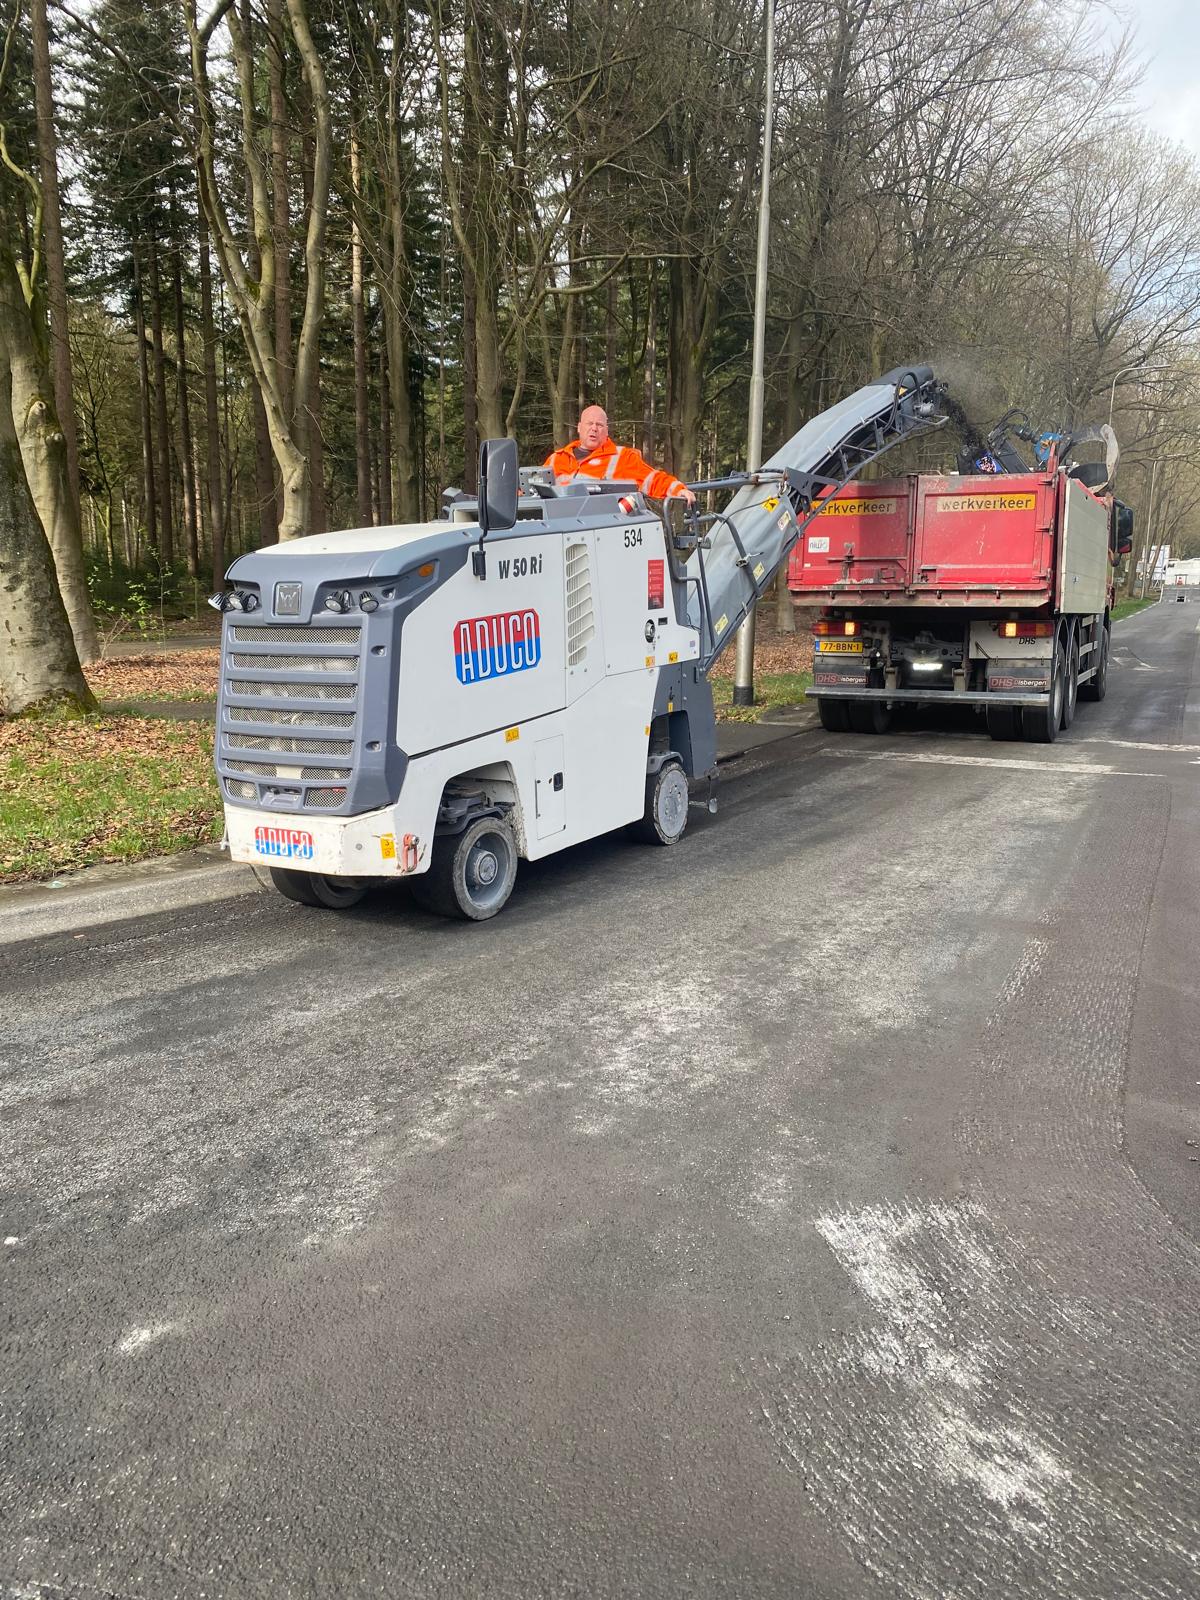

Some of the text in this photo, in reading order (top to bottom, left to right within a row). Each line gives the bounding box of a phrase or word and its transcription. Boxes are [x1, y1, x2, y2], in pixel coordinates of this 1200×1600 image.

[815, 502, 893, 515] erkverkeer
[942, 497, 1032, 511] werkverkeer
[624, 528, 643, 548] 534
[499, 553, 543, 579] W 50 Ri
[459, 611, 537, 683] ADUCO
[823, 642, 860, 652] 77-BBN-1
[1018, 637, 1036, 645] DHS
[817, 674, 837, 683] DHS
[991, 678, 1013, 687] DHS
[258, 827, 311, 859] ADUCO
